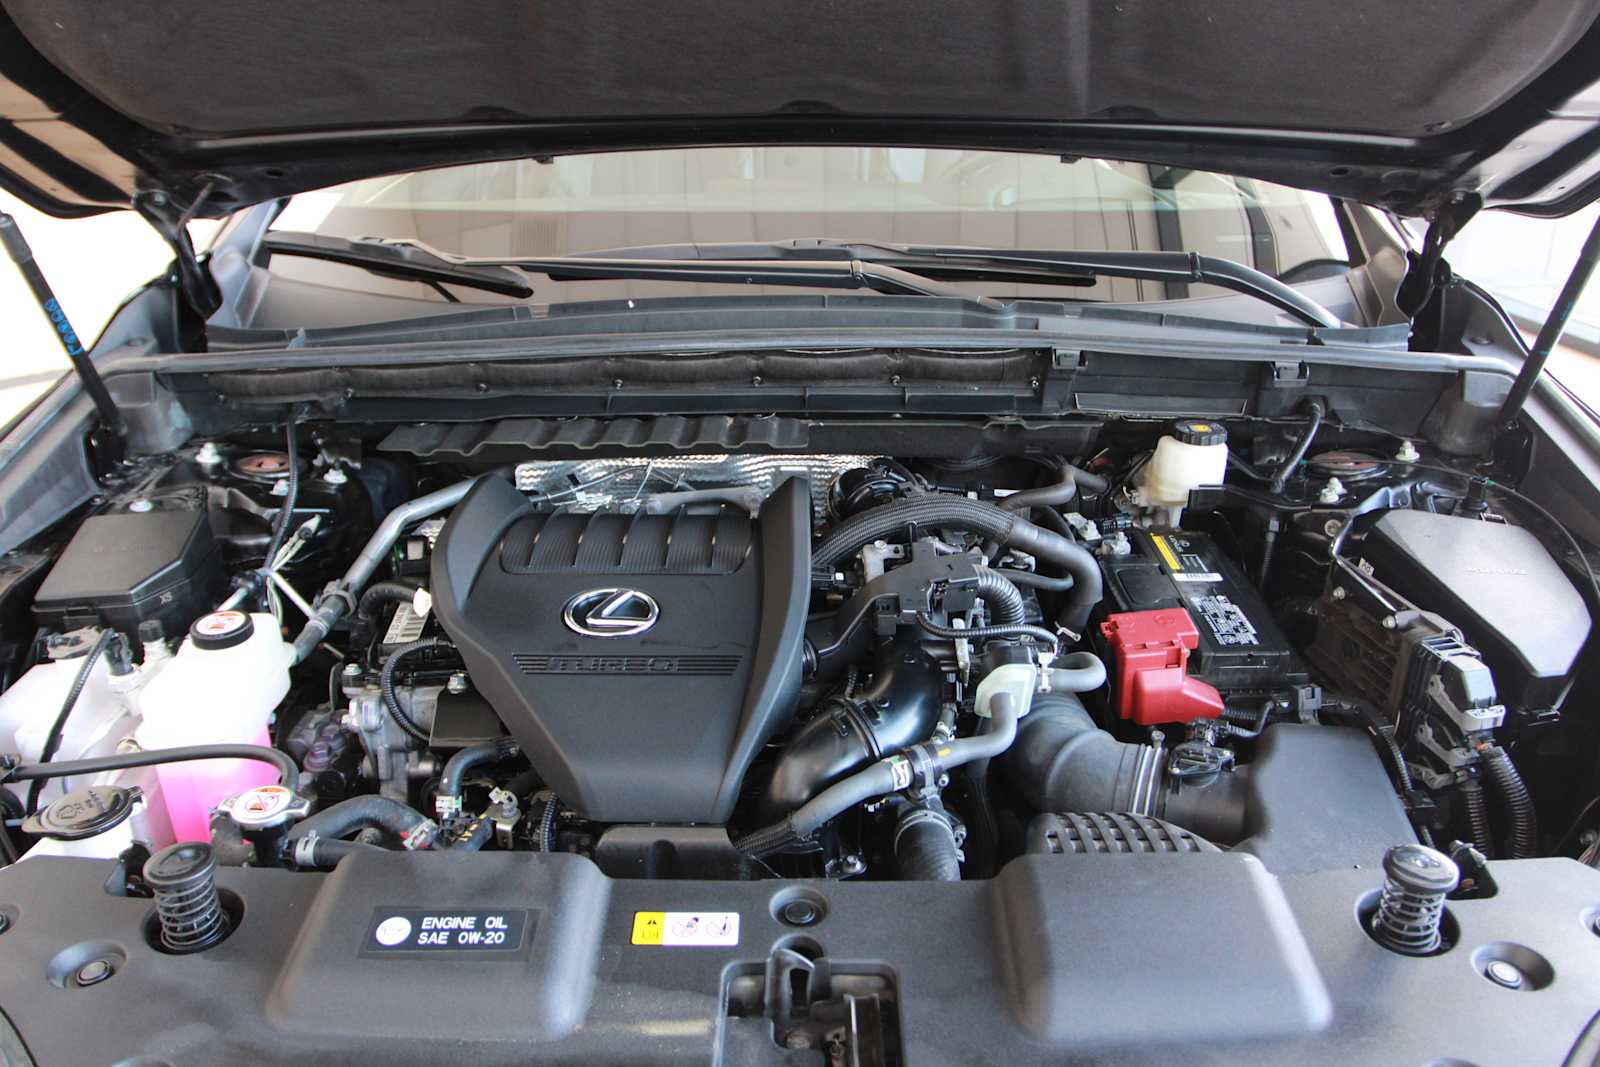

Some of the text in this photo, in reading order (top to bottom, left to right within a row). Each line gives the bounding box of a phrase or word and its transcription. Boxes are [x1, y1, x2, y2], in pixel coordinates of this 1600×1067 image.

[550, 656, 677, 672] TURBO
[421, 916, 508, 930] ENGINE OIL
[417, 931, 449, 944] SAE
[457, 931, 506, 944] 0W-20
